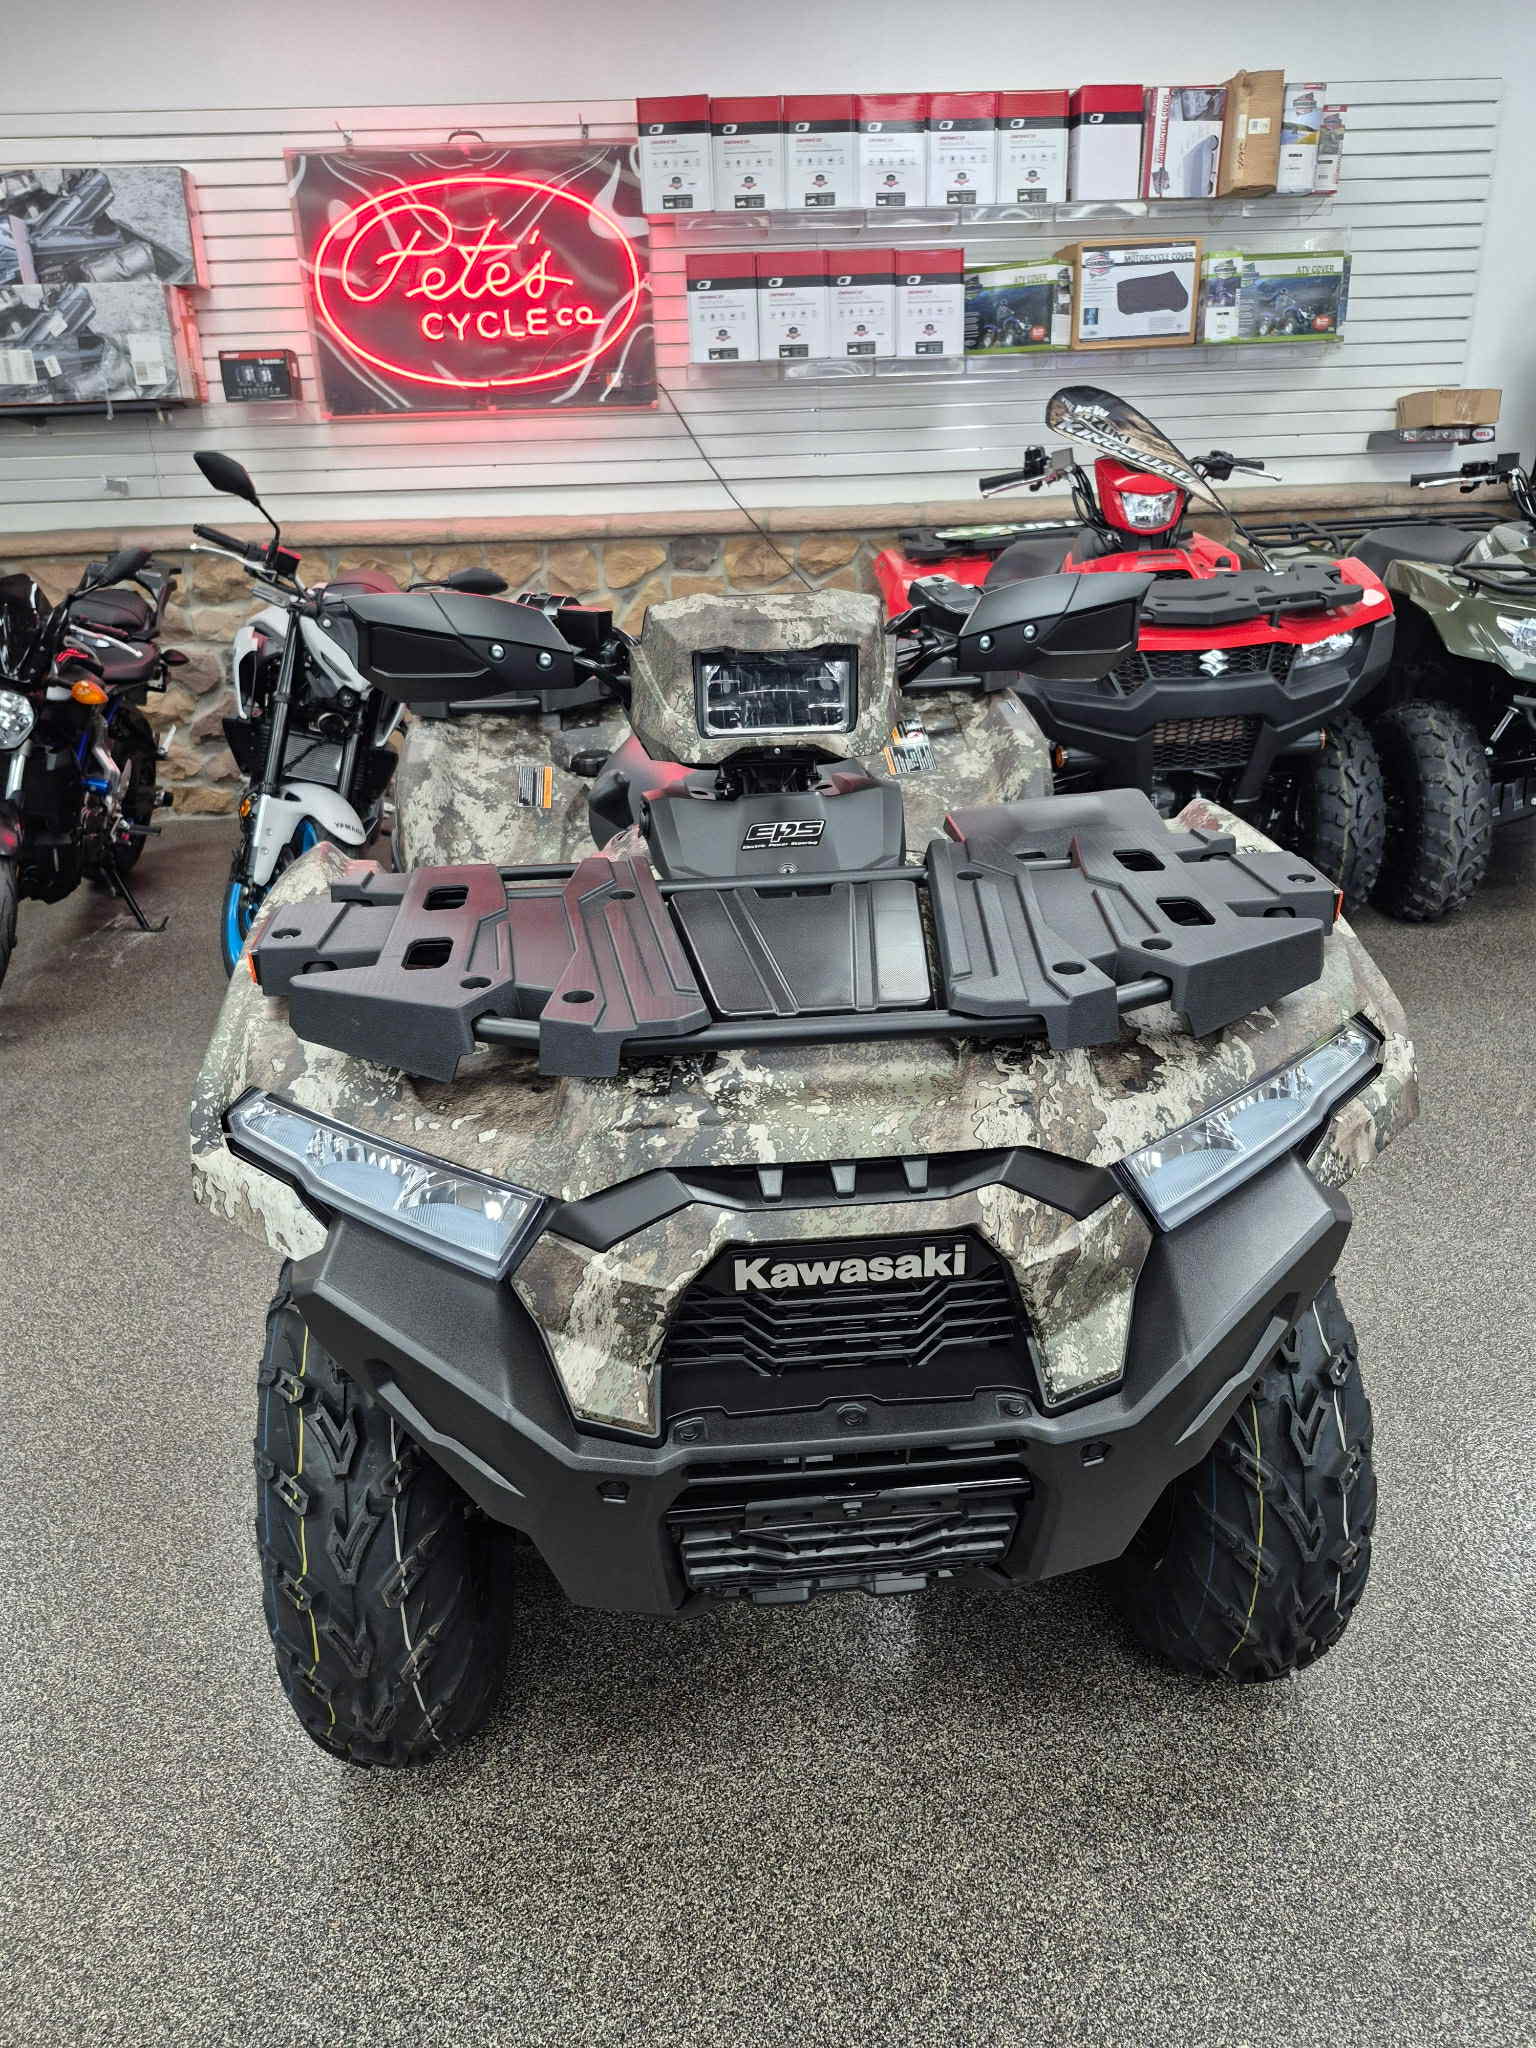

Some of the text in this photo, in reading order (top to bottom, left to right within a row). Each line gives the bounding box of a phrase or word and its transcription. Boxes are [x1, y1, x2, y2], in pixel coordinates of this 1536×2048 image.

[340, 202, 574, 302] Pete's
[420, 306, 550, 341] CYCLE
[734, 1244, 966, 1291] Kawasaki
